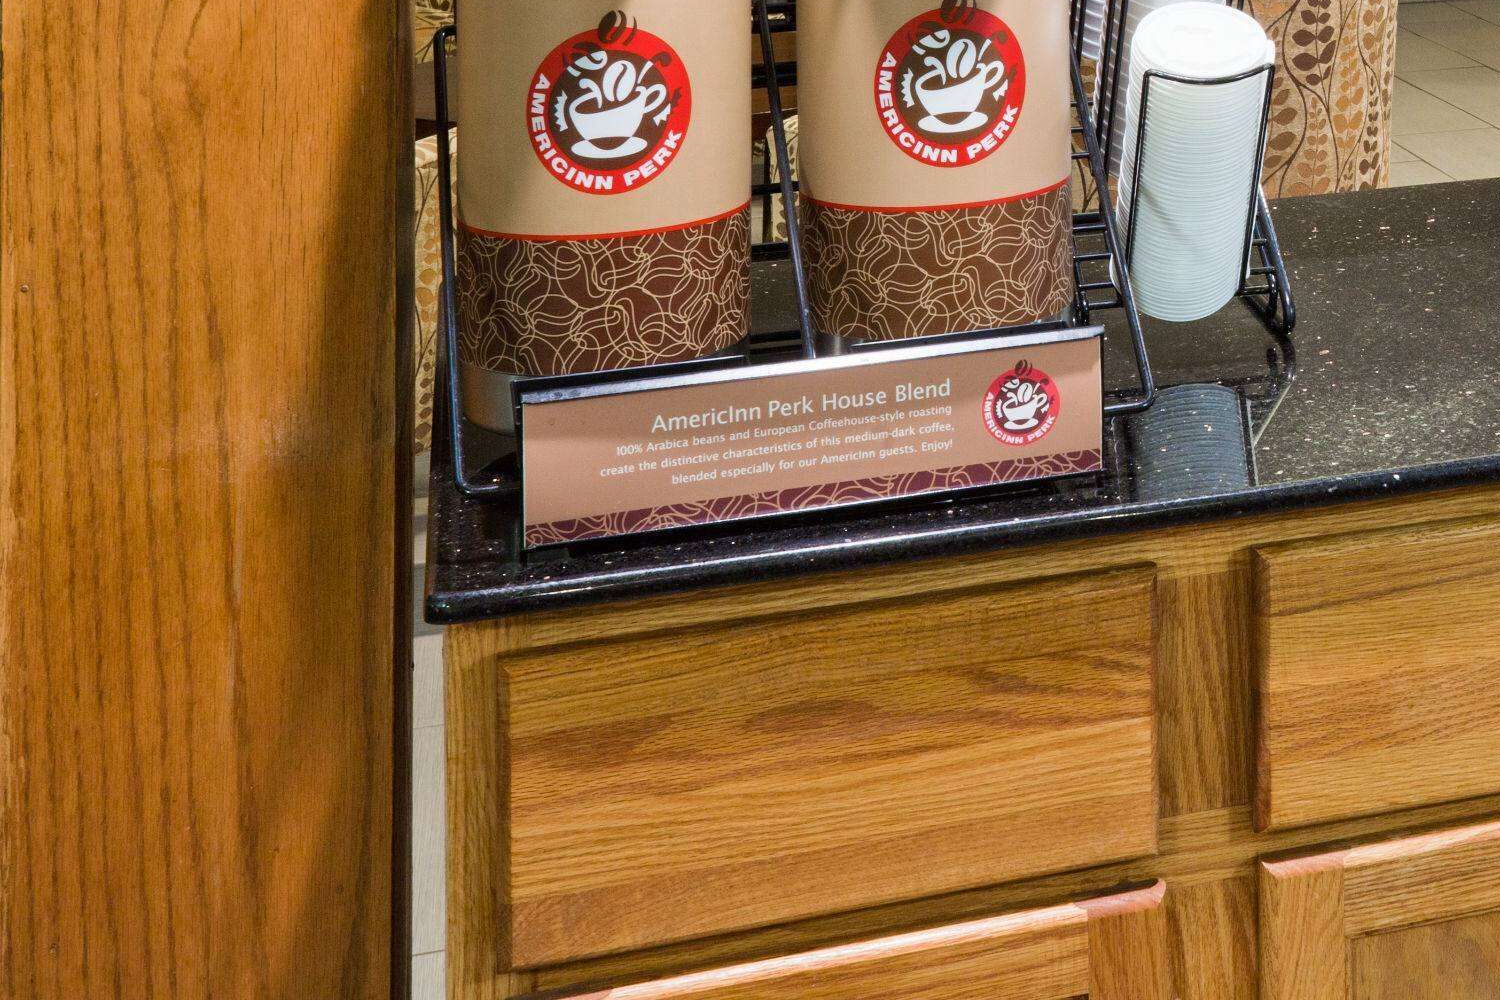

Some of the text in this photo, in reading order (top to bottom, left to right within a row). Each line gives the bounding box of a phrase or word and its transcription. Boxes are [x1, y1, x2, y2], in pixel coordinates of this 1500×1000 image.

[531, 73, 682, 190] AMERICINN PERK
[879, 51, 1018, 163] AMERICINN PERK
[616, 404, 952, 456] 100% Arabica beans and European Coffeehouse-style roasting
[651, 378, 951, 433] AmericInn Perk House Blend
[984, 392, 1056, 444] AMERICINN PERK
[600, 465, 636, 477] create
[639, 459, 657, 471] the
[660, 453, 719, 468] distinctive
[722, 440, 802, 459] characteristics
[806, 437, 818, 449] of
[821, 434, 841, 446] this
[845, 425, 916, 444] medium-dark
[671, 439, 953, 485] blended especially for our AmericInn guests. Enjoy!
